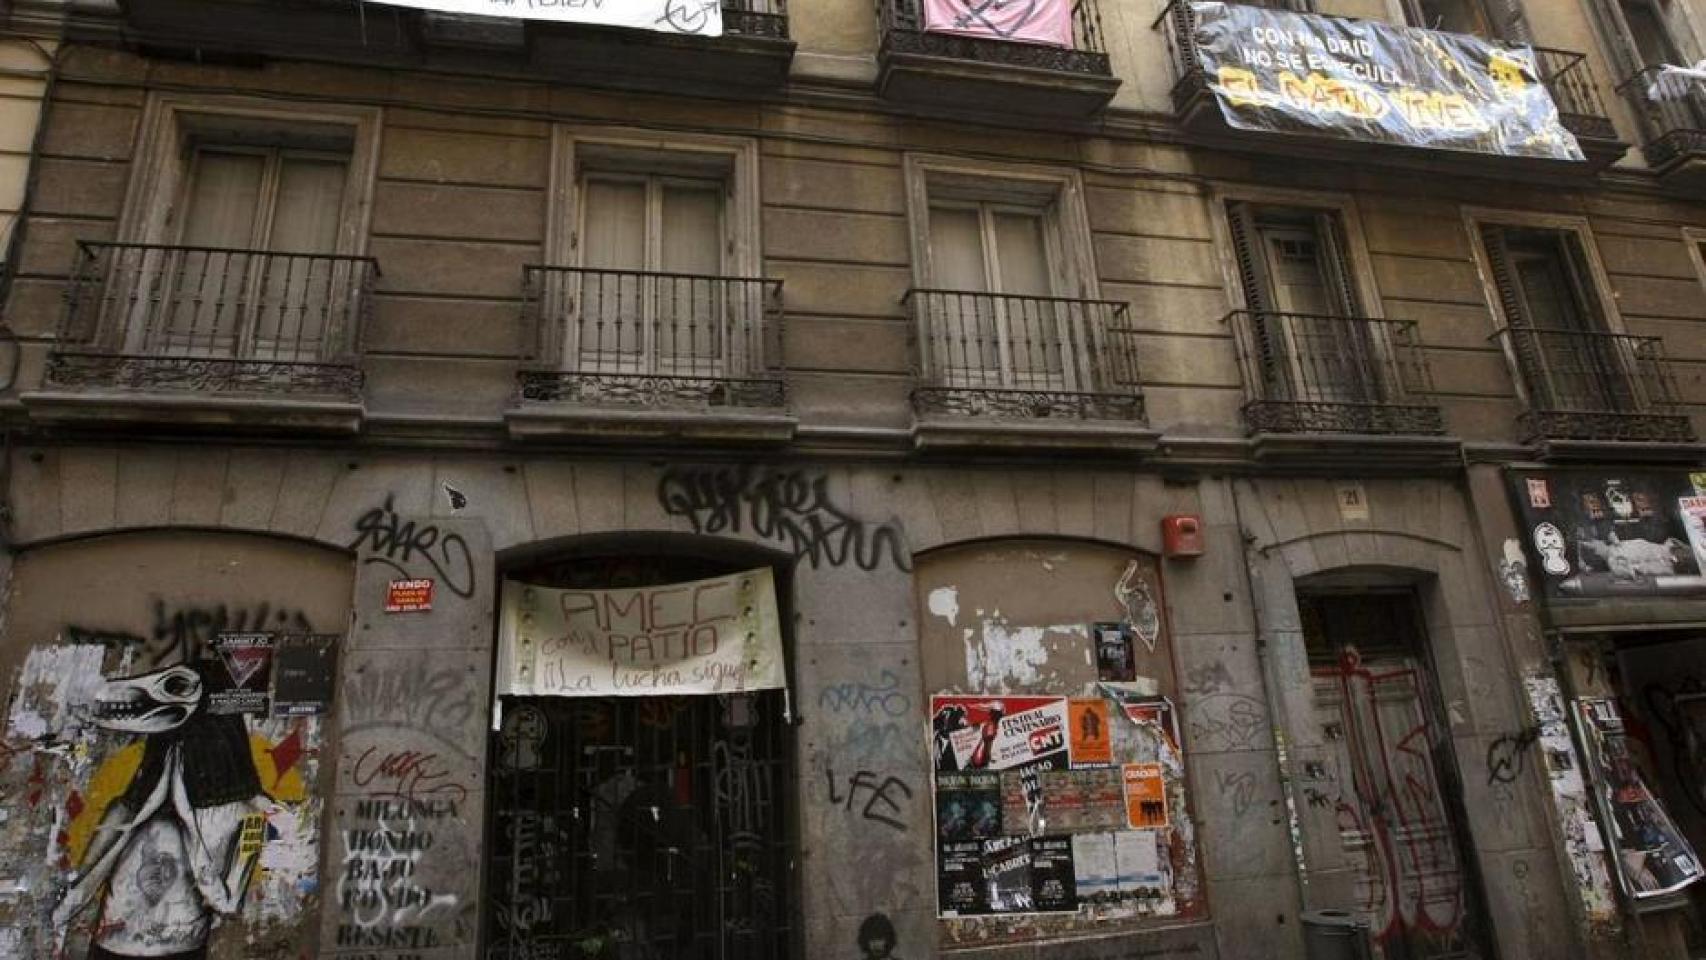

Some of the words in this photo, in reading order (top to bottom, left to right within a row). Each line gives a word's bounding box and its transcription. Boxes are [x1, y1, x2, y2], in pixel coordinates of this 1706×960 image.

[1252, 26, 1295, 47] CON
[1242, 49, 1272, 68] NO
[1275, 52, 1305, 70] SE
[607, 624, 718, 662] PATIO
[1029, 729, 1063, 753] CNT
